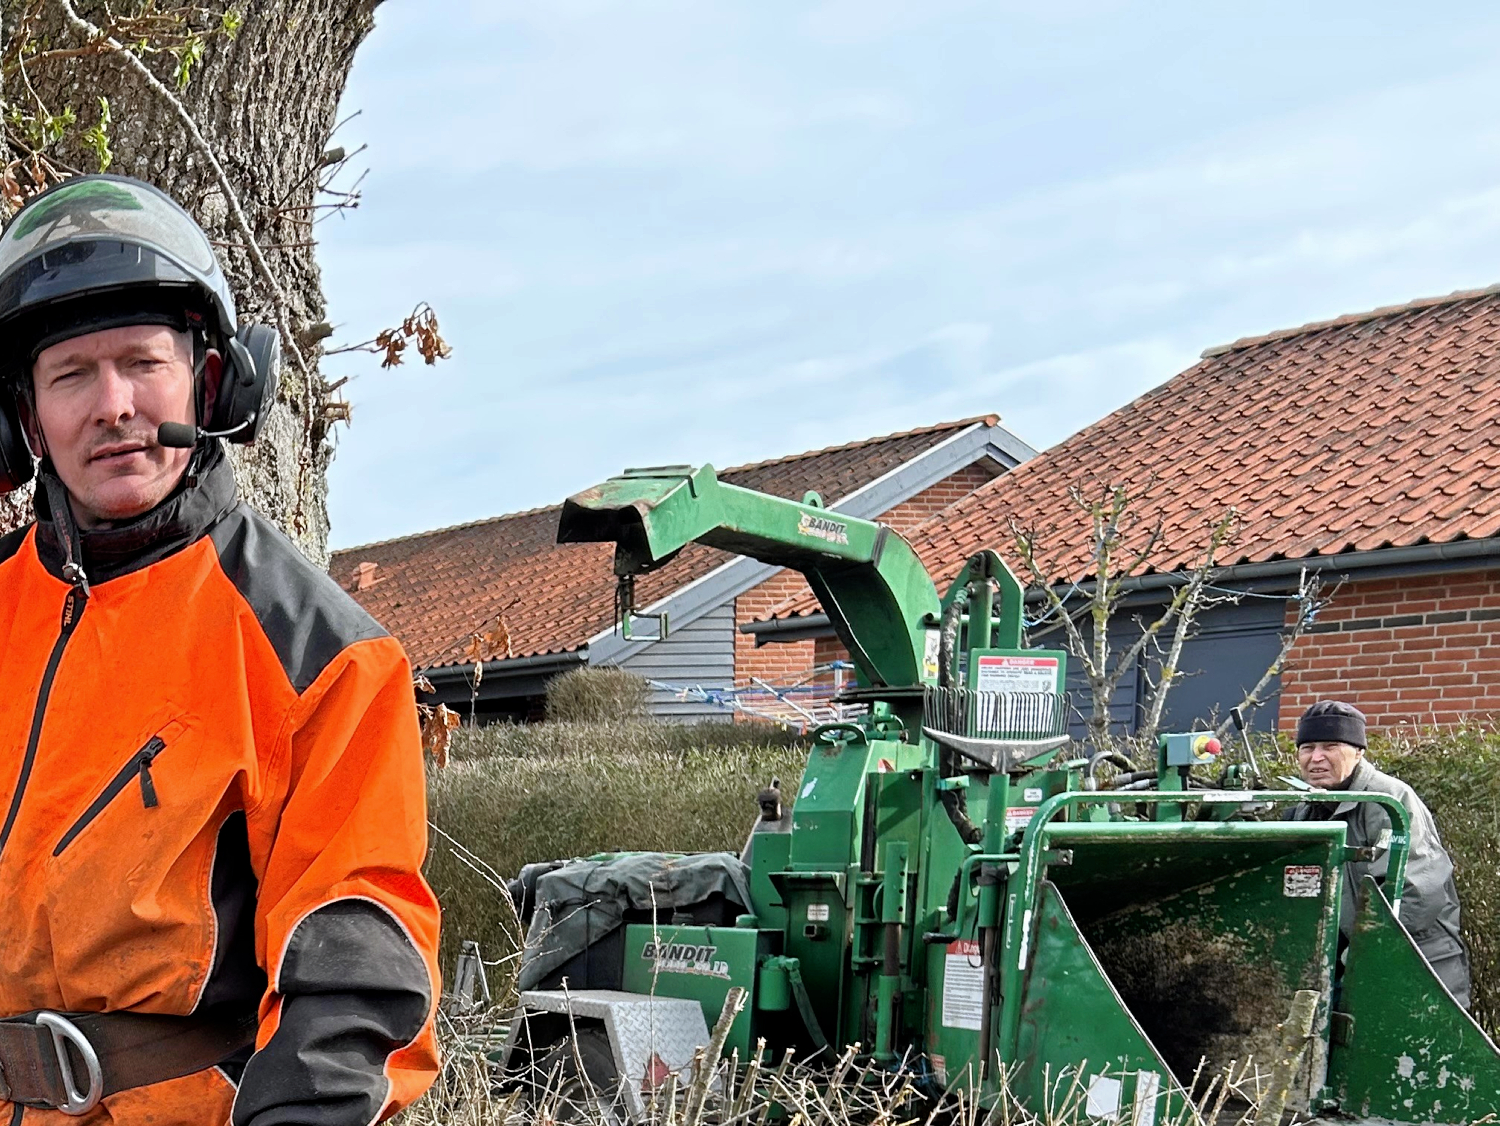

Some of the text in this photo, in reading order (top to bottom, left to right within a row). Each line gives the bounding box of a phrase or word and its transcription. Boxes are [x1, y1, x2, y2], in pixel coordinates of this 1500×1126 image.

[809, 517, 846, 534] BANDIT
[63, 595, 74, 627] STIHL
[642, 943, 716, 962] BANDIT
